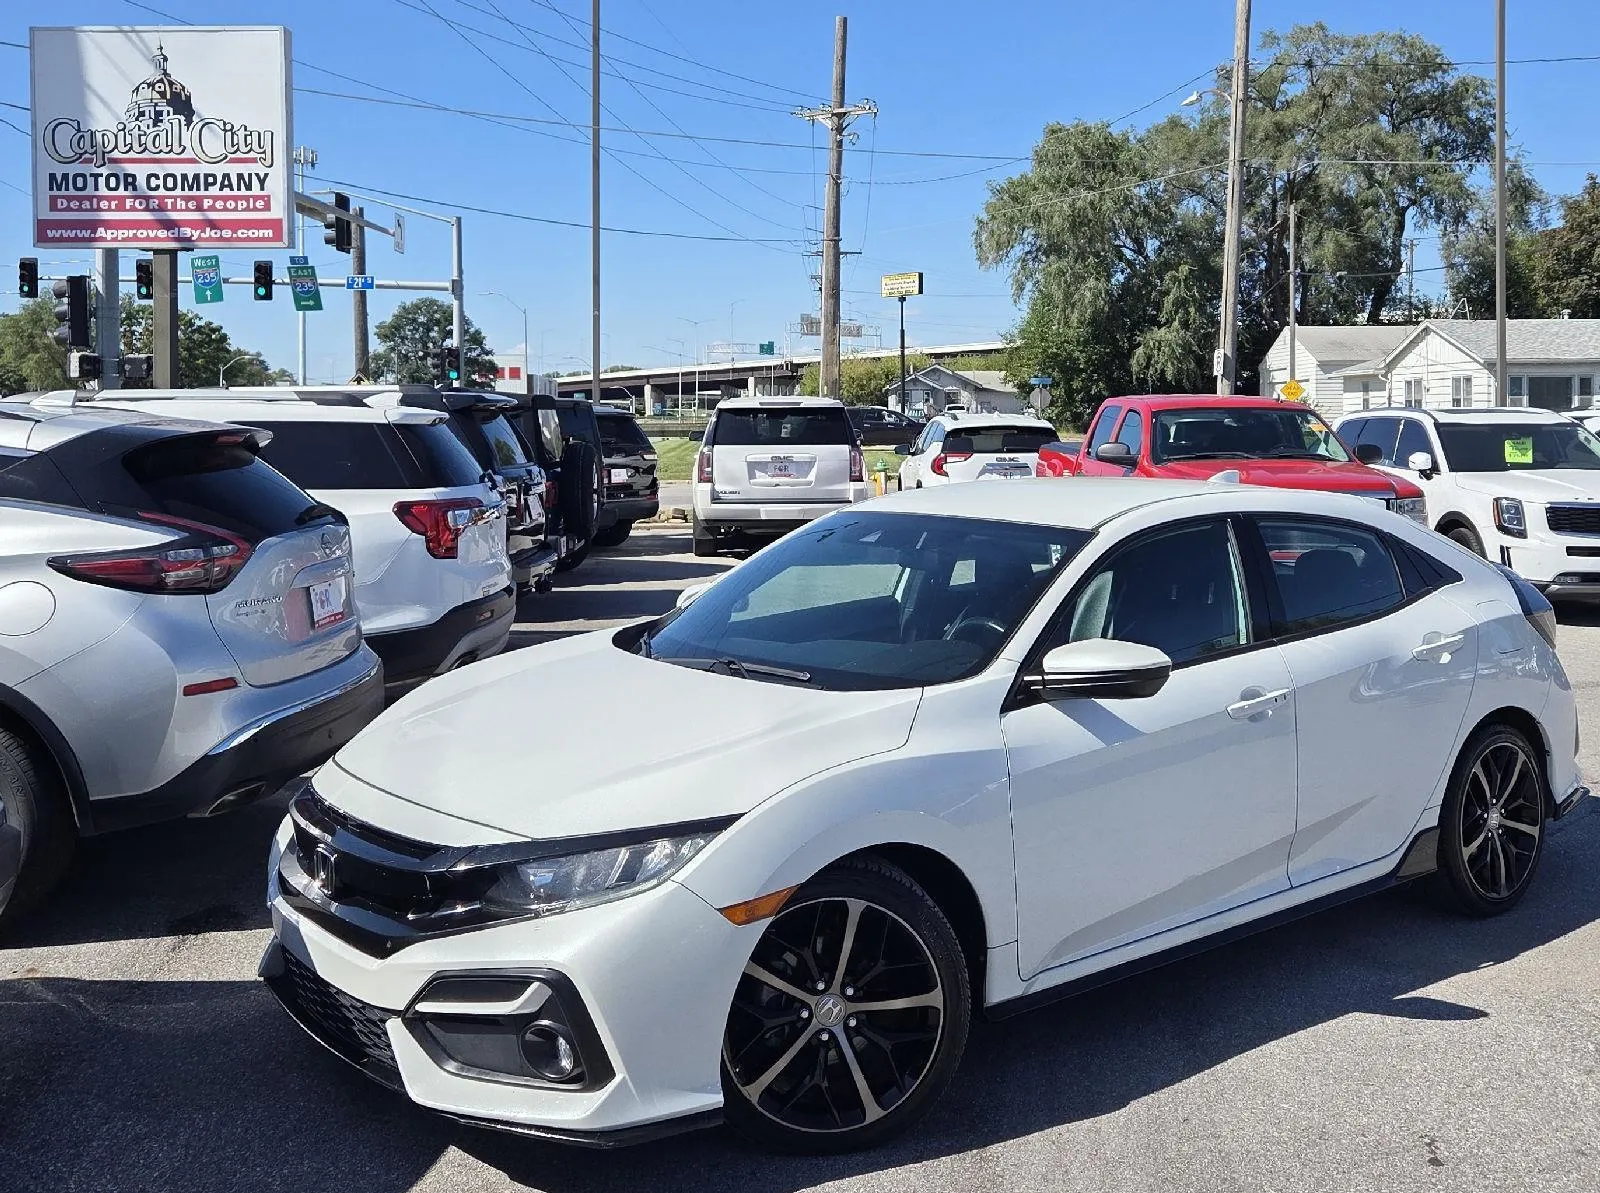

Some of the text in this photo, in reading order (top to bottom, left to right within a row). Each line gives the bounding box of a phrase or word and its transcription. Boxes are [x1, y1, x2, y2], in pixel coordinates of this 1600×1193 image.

[43, 116, 274, 168] Capital City
[48, 172, 270, 192] MOTOR COMPANY
[57, 198, 265, 211] Dealer FOR The People
[46, 227, 273, 241] www.ApprovedByJoe.com
[193, 258, 217, 267] WEST
[197, 272, 217, 283] 235
[290, 268, 312, 276] EAST
[295, 281, 315, 292] 235
